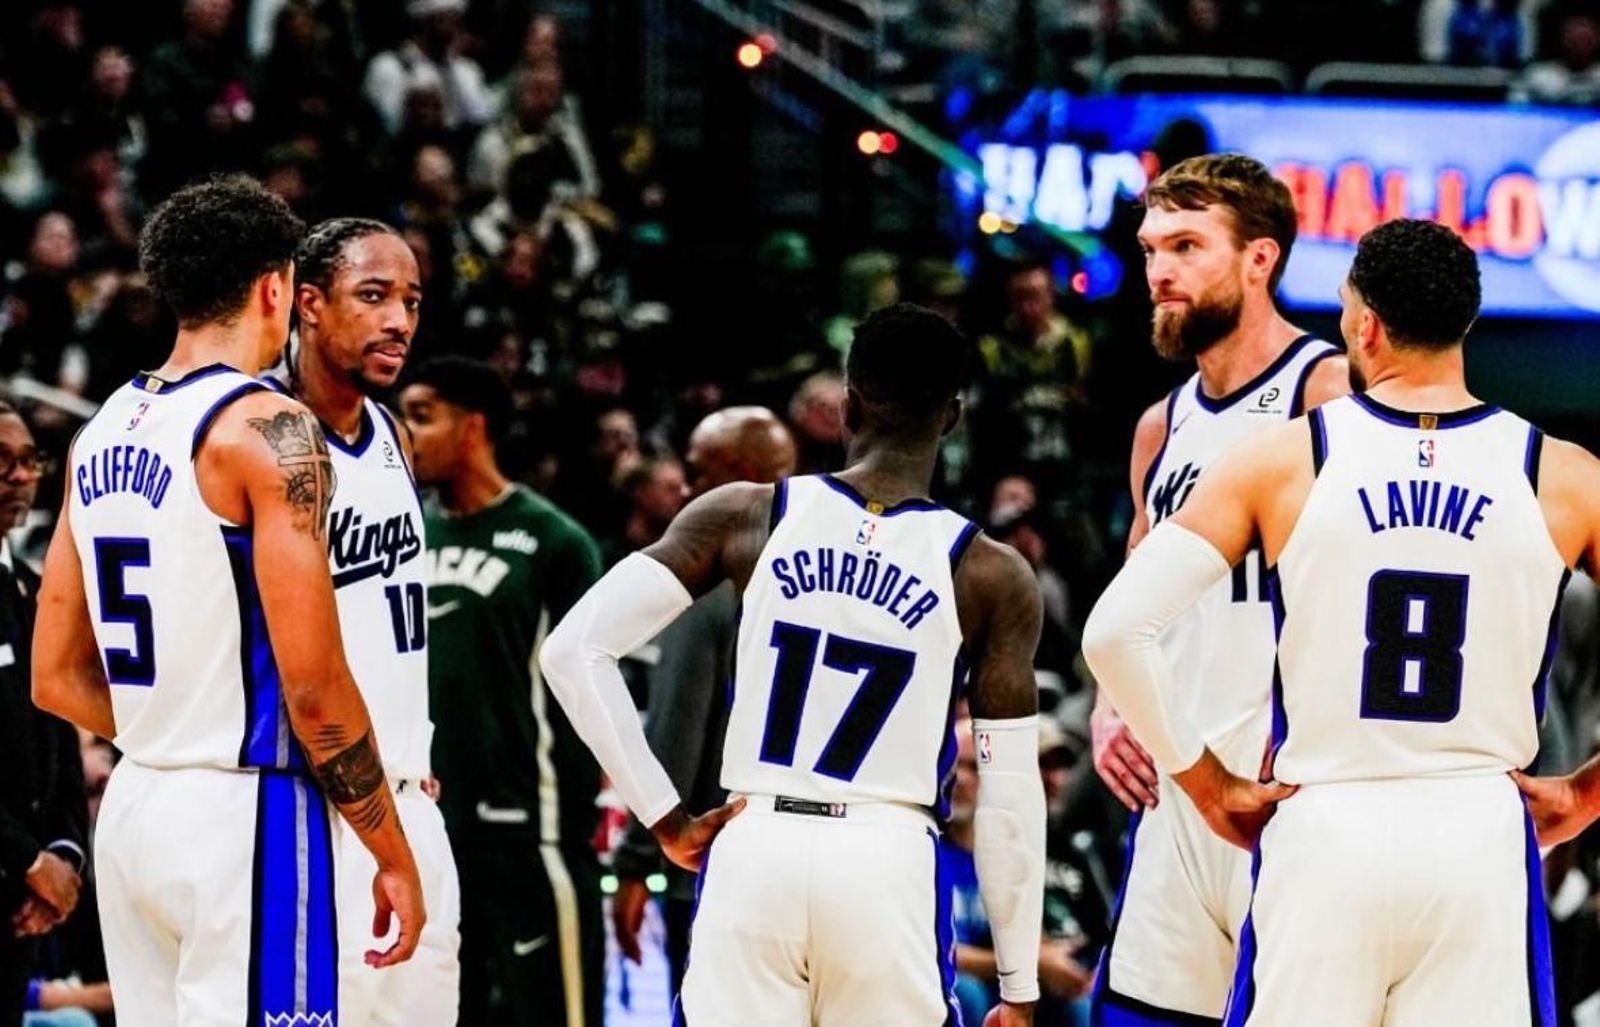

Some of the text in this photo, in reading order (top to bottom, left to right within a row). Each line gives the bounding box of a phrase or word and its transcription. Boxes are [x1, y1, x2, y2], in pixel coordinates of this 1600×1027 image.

[979, 143, 1148, 231] HAP
[77, 445, 173, 510] CLIFFORD
[1357, 479, 1493, 541] LAVINE
[327, 506, 421, 589] Kings
[427, 545, 511, 598] CKS
[771, 547, 940, 631] SCHRÖDER
[94, 536, 156, 687] 5
[384, 581, 425, 655] 10
[1359, 567, 1470, 724] 8
[758, 619, 917, 783] 17
